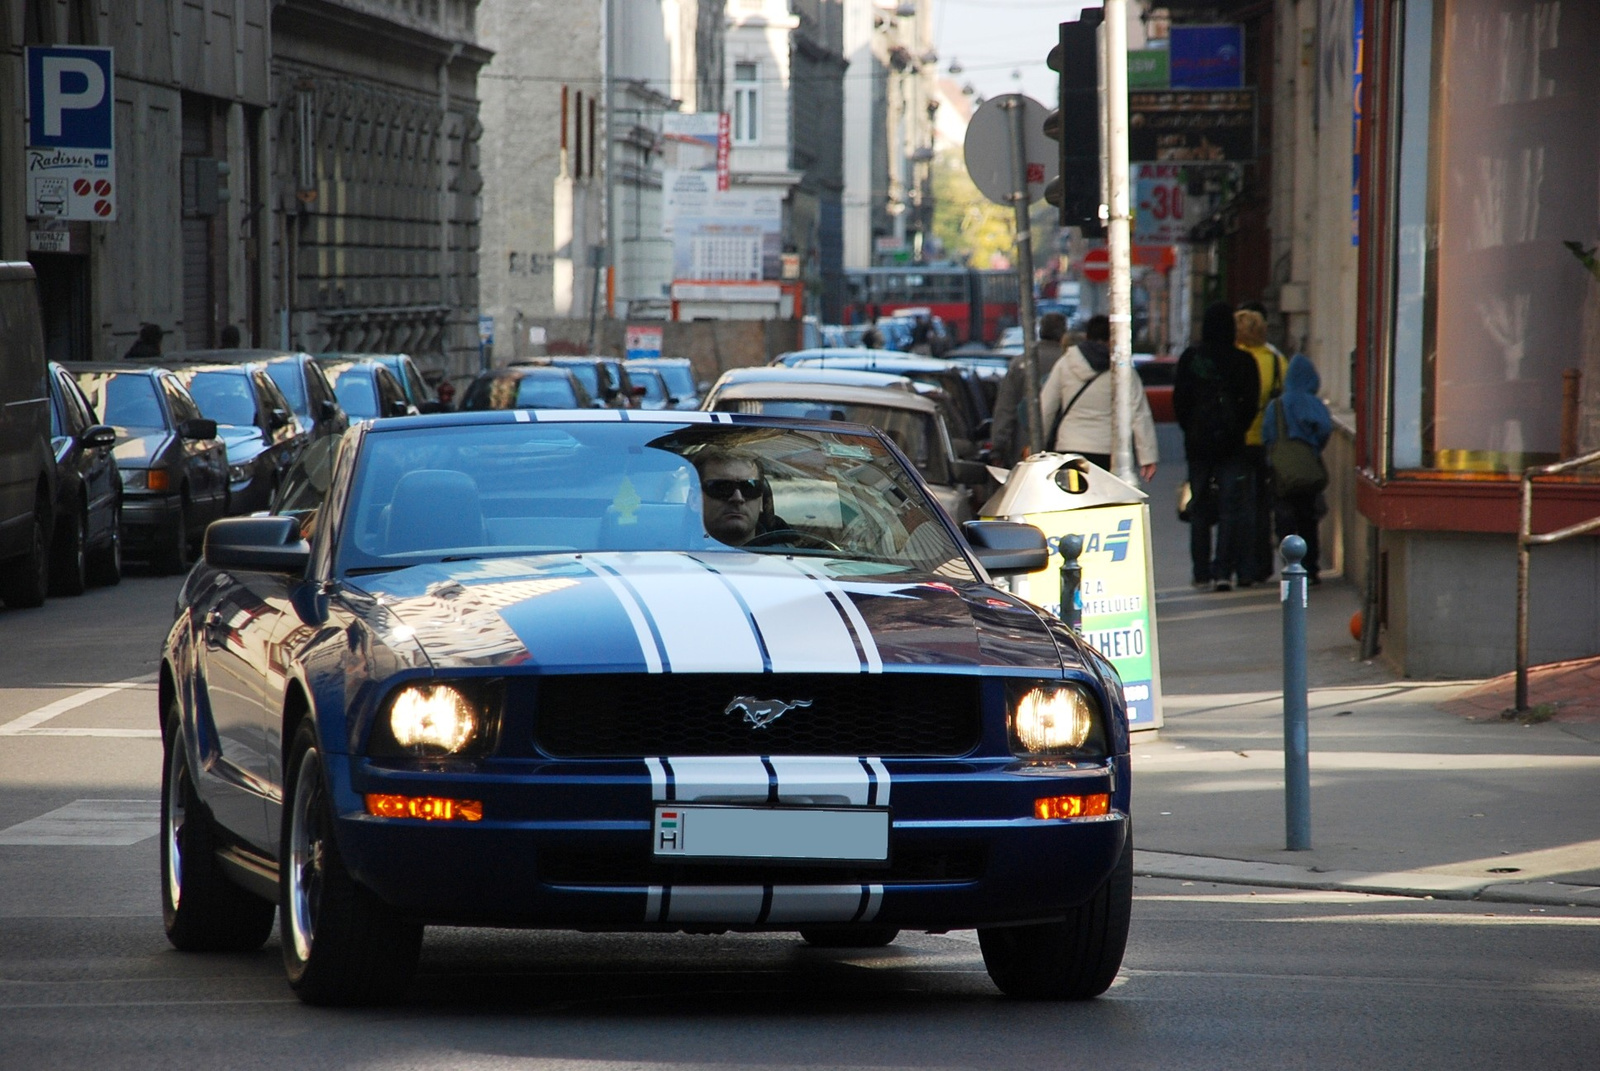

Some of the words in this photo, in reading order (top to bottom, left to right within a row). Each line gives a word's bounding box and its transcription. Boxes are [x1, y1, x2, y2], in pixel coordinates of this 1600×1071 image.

[42, 56, 105, 136] P
[30, 150, 93, 171] Radisson
[661, 831, 677, 849] H
